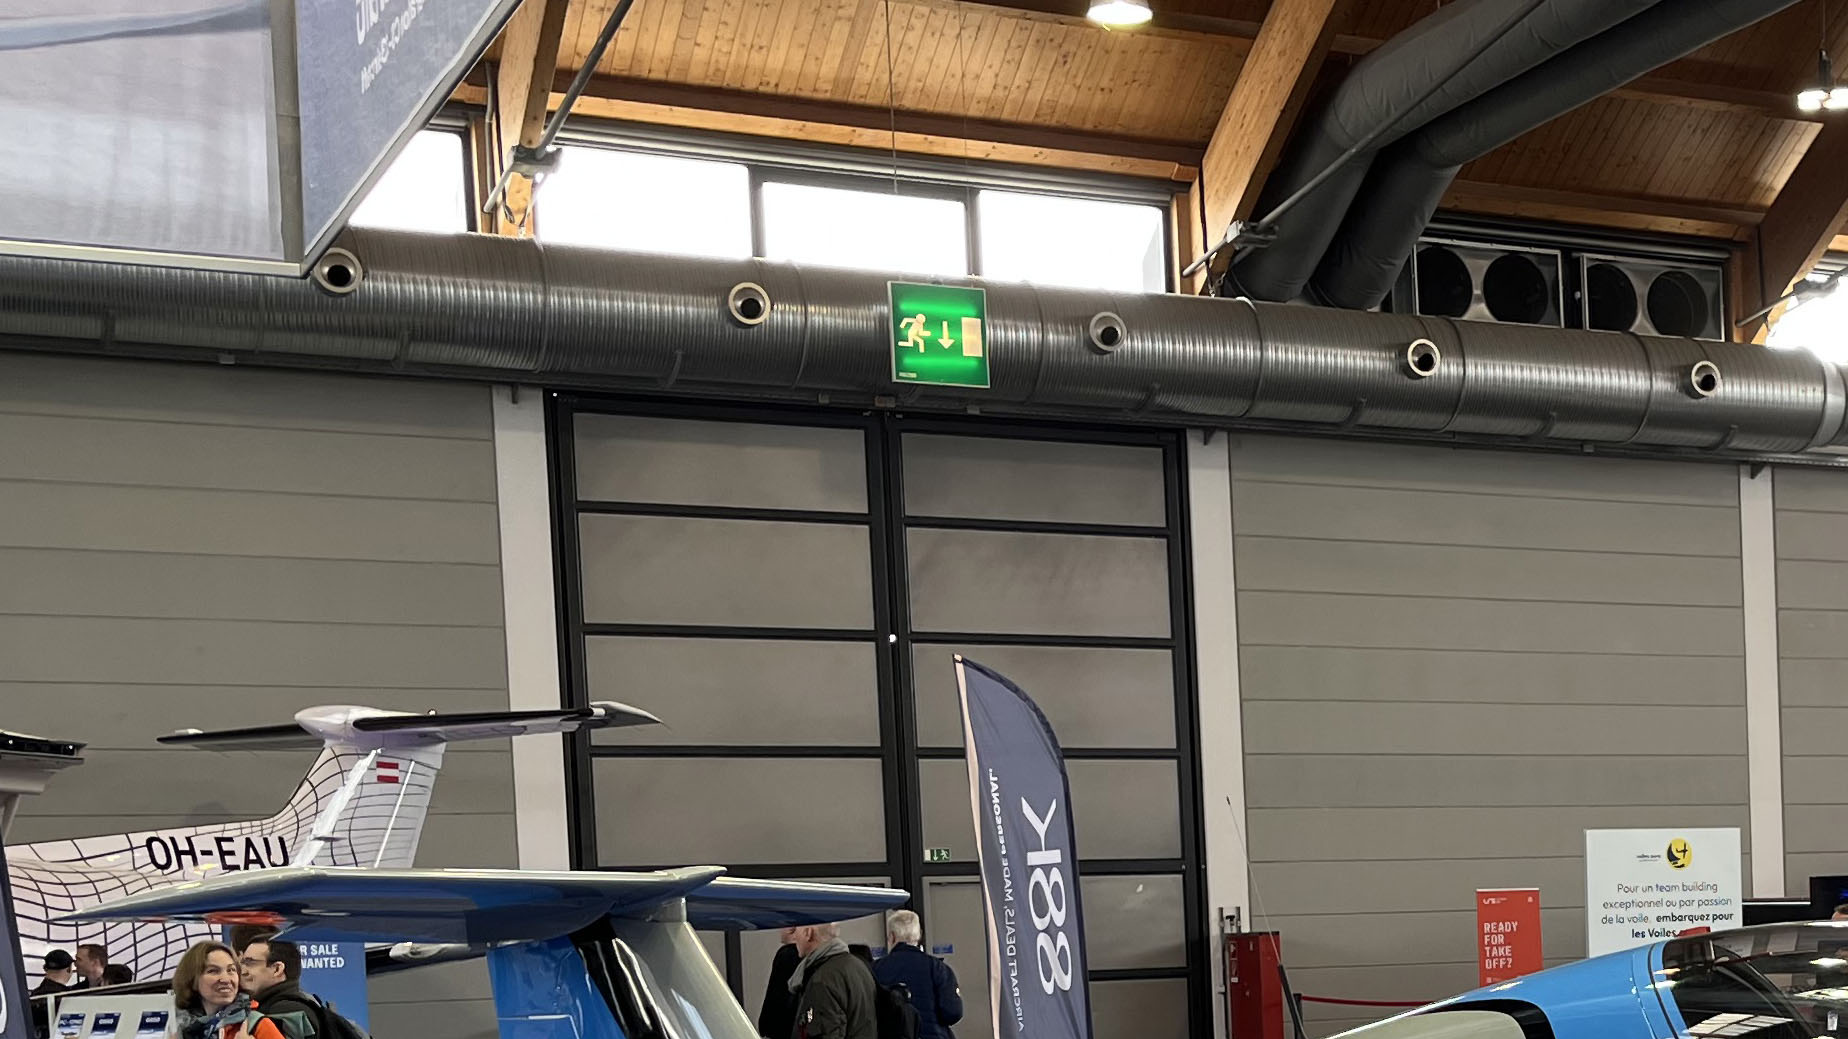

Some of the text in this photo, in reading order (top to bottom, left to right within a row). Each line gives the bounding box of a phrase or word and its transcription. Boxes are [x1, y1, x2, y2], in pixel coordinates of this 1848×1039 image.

[146, 836, 290, 871] OH-EAU
[1617, 881, 1718, 894] Pour un team building
[1602, 897, 1732, 911] exceptionnel ou par passion
[1601, 914, 1614, 924] de
[1615, 914, 1625, 924] la
[1655, 912, 1710, 925] embarquez
[1712, 912, 1735, 923] pour
[1483, 921, 1518, 933] READY
[1484, 934, 1505, 945] FOR
[1631, 928, 1646, 939] les
[310, 944, 339, 956] SALE
[1484, 945, 1512, 957] TAKE
[1485, 957, 1513, 970] OFF?
